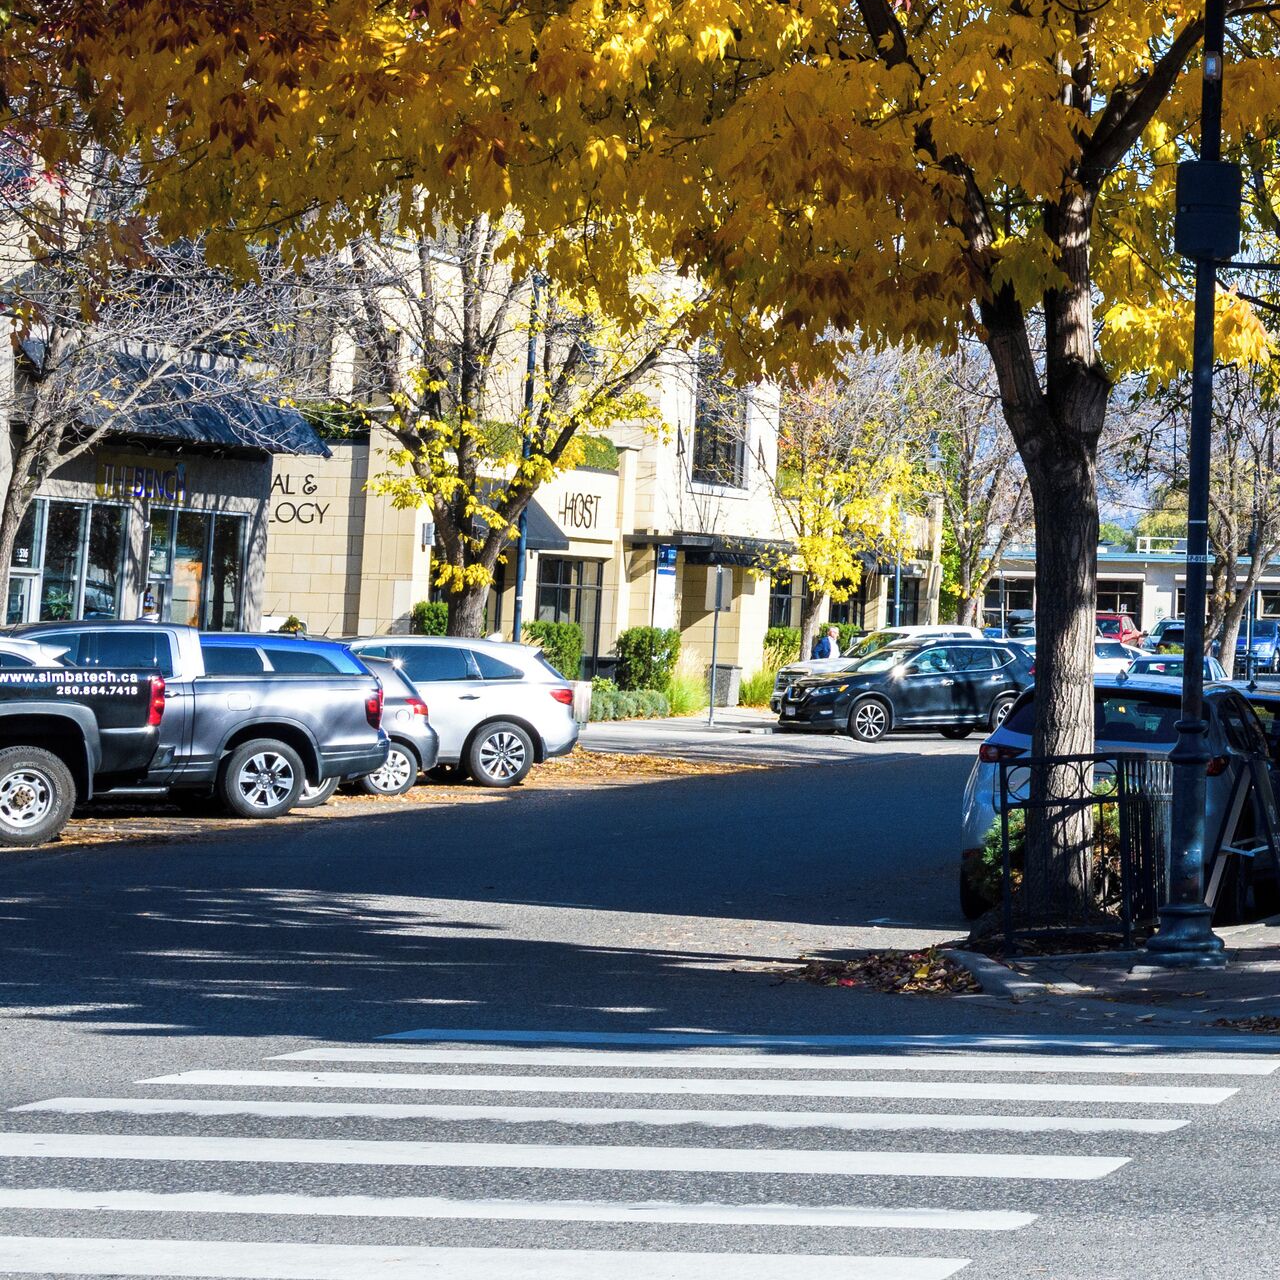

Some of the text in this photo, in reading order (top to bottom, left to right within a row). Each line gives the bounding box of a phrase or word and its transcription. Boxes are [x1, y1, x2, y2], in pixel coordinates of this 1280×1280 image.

[302, 474, 318, 495] &
[562, 491, 601, 529] HOST
[0, 671, 138, 683] www.simbatech.ca
[56, 686, 138, 695] 250.864.7418
